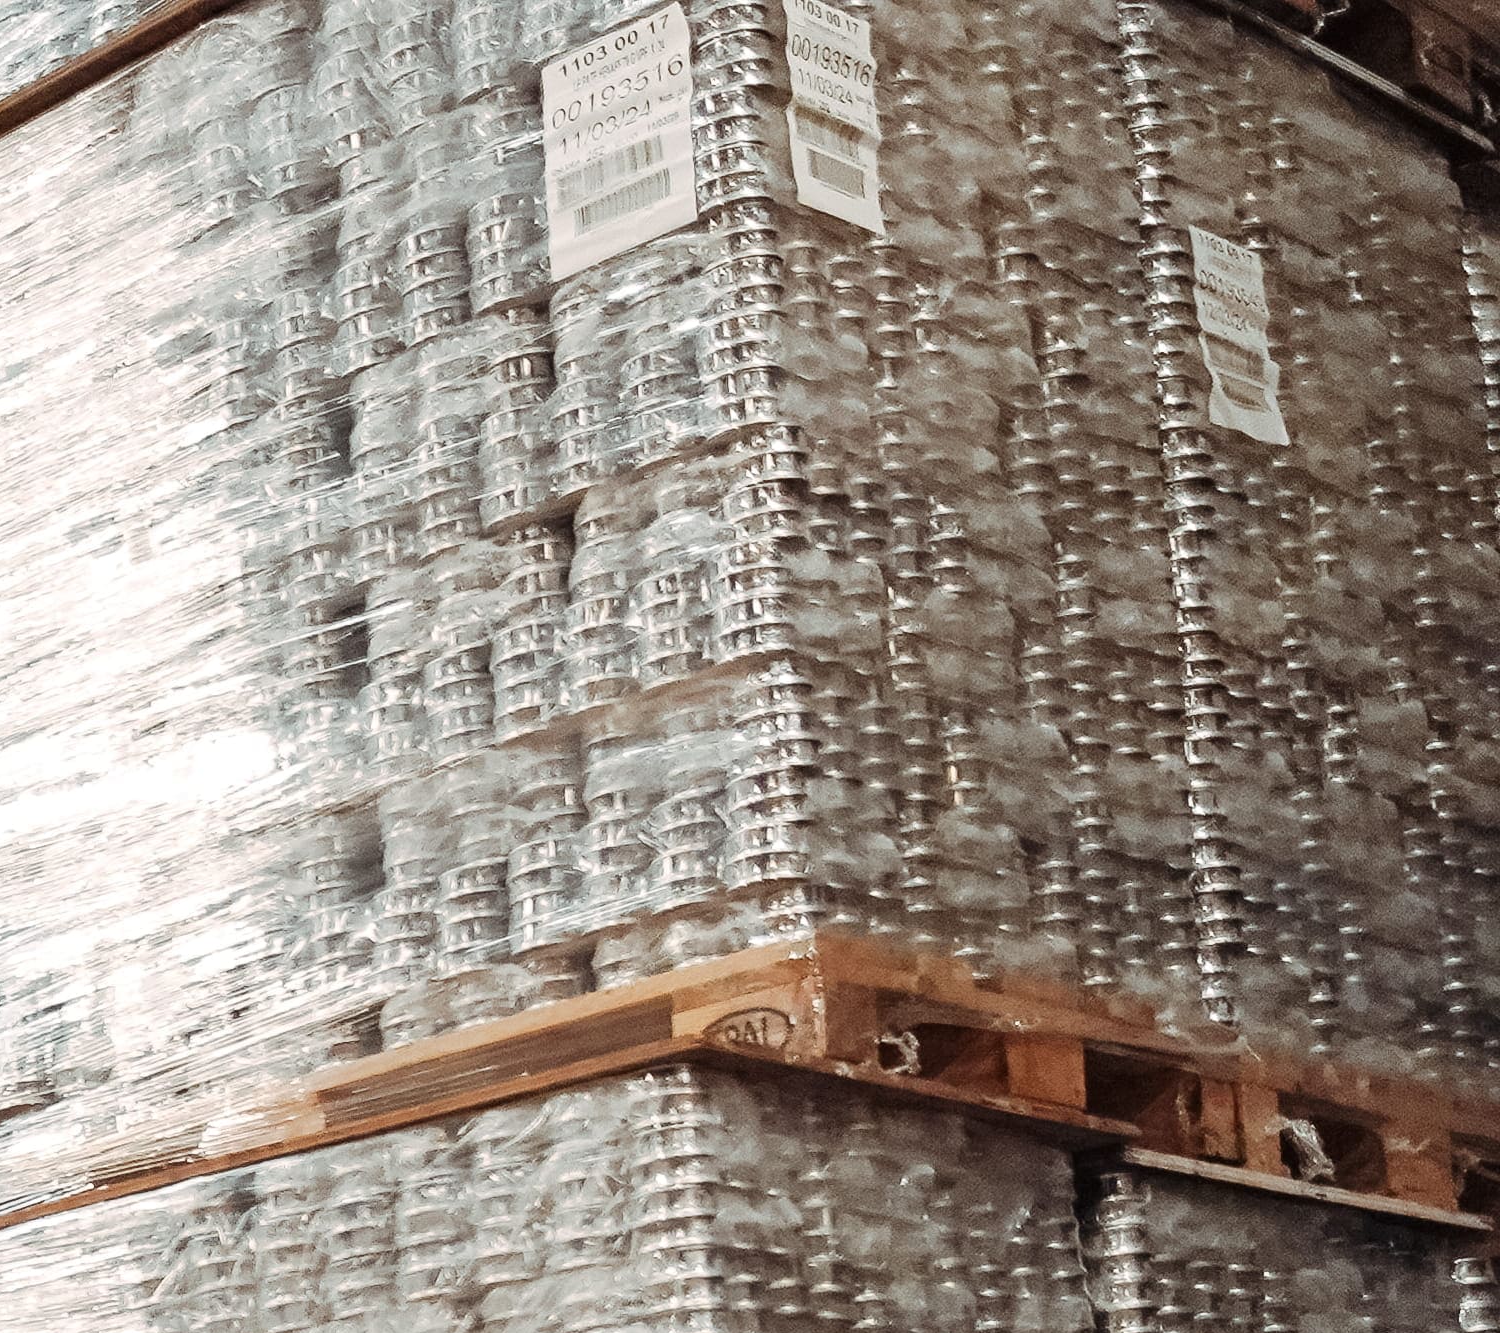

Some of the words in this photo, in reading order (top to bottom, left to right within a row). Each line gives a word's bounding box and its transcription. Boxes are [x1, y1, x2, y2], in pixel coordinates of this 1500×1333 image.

[559, 45, 608, 77] 1103
[614, 30, 638, 51] 00
[649, 14, 669, 35] 17
[826, 11, 841, 28] 00
[792, 34, 871, 87] 00193516
[552, 54, 683, 130] 00193516
[560, 100, 650, 154] 11/03/24
